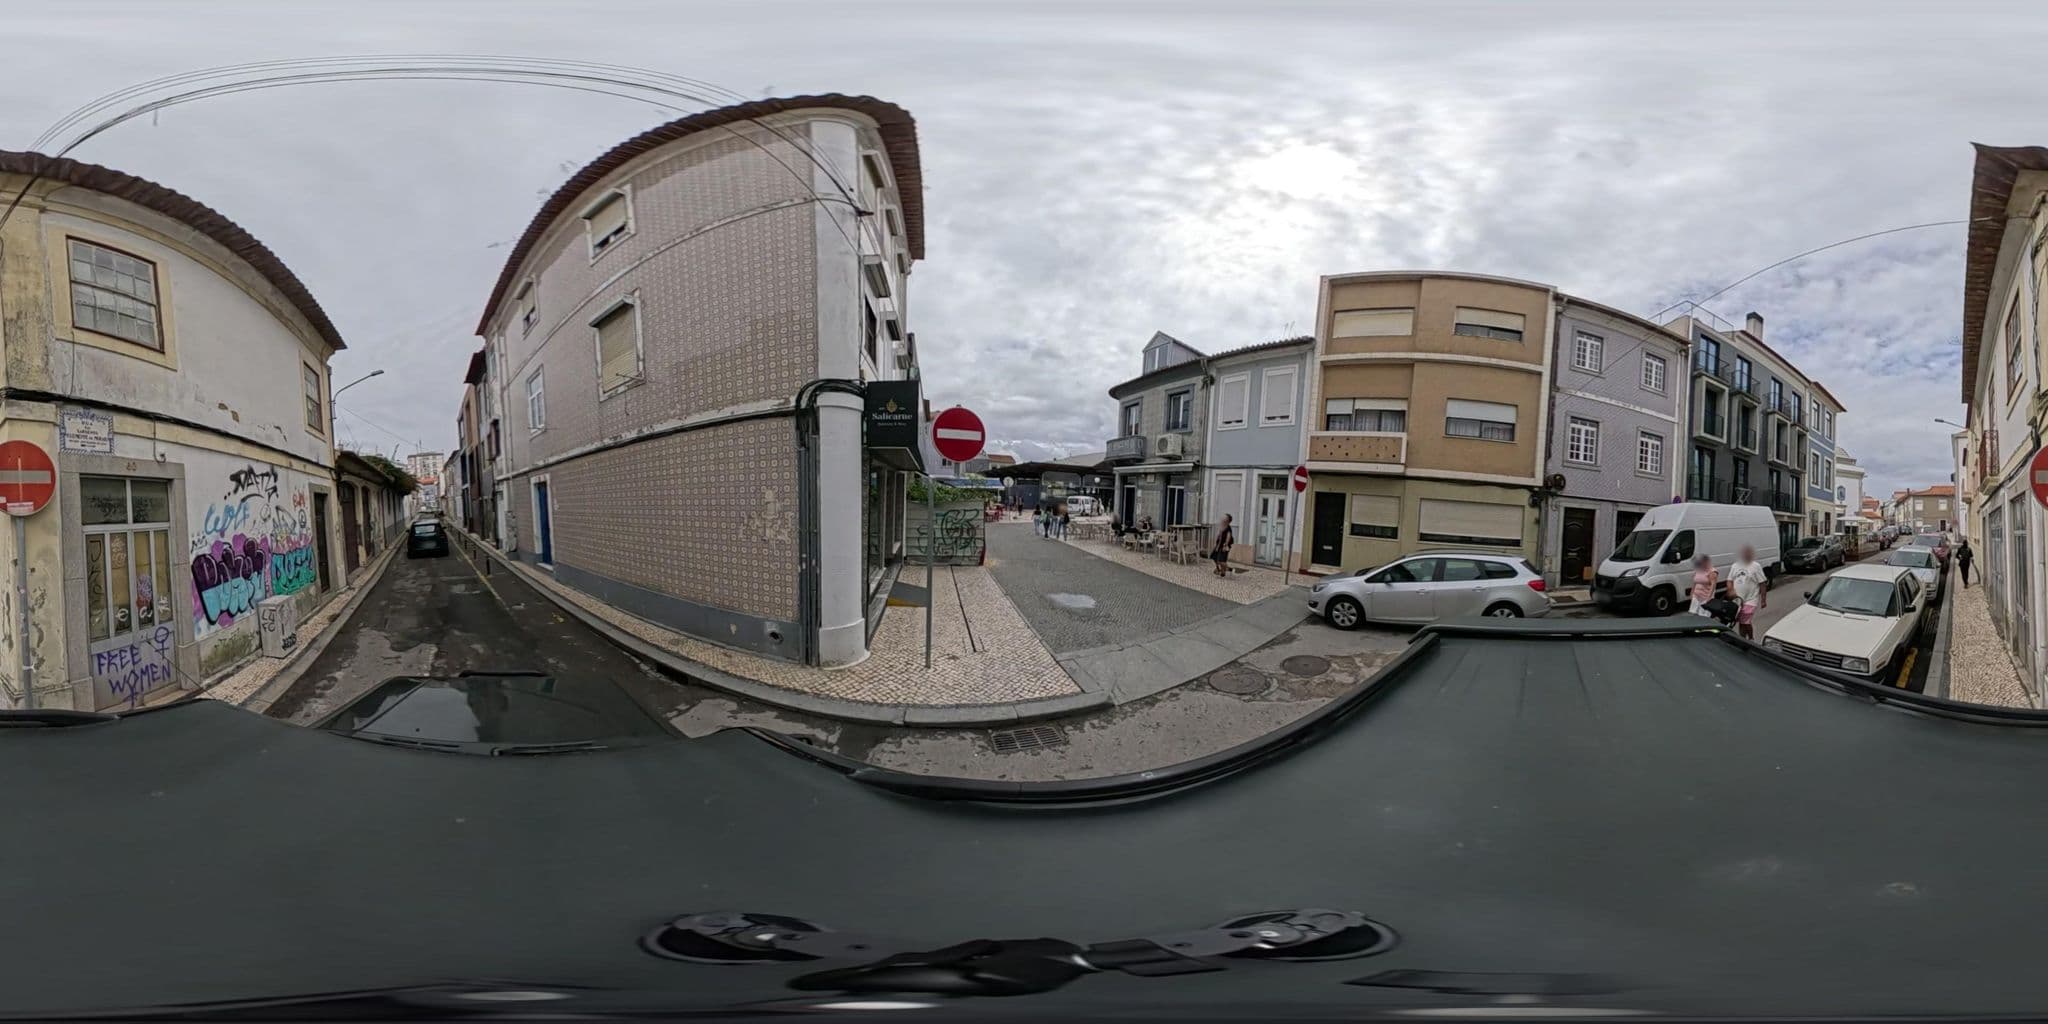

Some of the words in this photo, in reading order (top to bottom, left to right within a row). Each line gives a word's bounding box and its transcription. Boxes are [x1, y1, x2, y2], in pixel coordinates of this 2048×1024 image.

[872, 412, 912, 420] Salicarne
[96, 643, 142, 676] FREE
[108, 660, 171, 708] WOMEN
